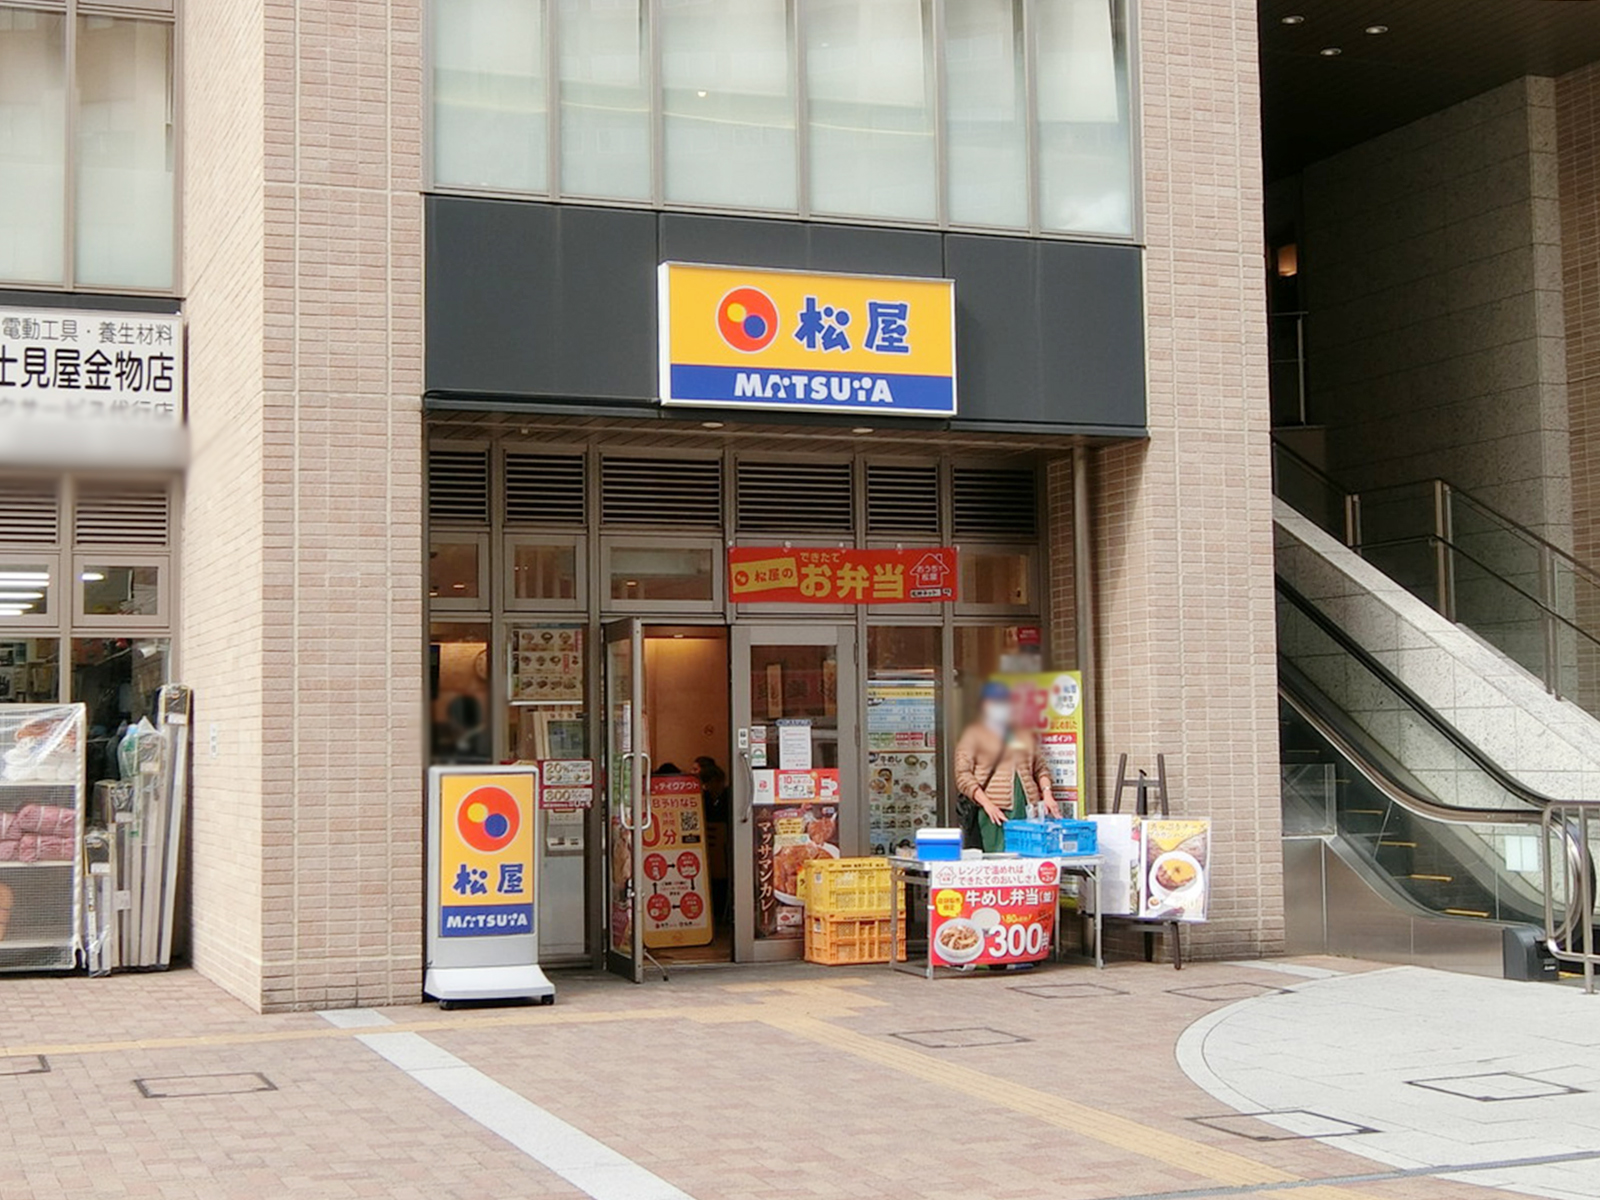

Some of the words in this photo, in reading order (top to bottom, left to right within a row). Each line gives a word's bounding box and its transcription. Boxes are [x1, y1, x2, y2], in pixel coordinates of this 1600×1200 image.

[2, 317, 173, 345] 電動工具・養生材料
[794, 297, 910, 354] 松屋
[734, 373, 893, 403] MATSUYA
[801, 552, 840, 563] できたて
[754, 568, 793, 583] 松屋の
[800, 562, 904, 600] お弁当
[453, 864, 524, 895] 松屋
[965, 887, 1038, 907] 牛めし弁当
[446, 913, 528, 929] MATSUYA
[988, 922, 1043, 958] 300
